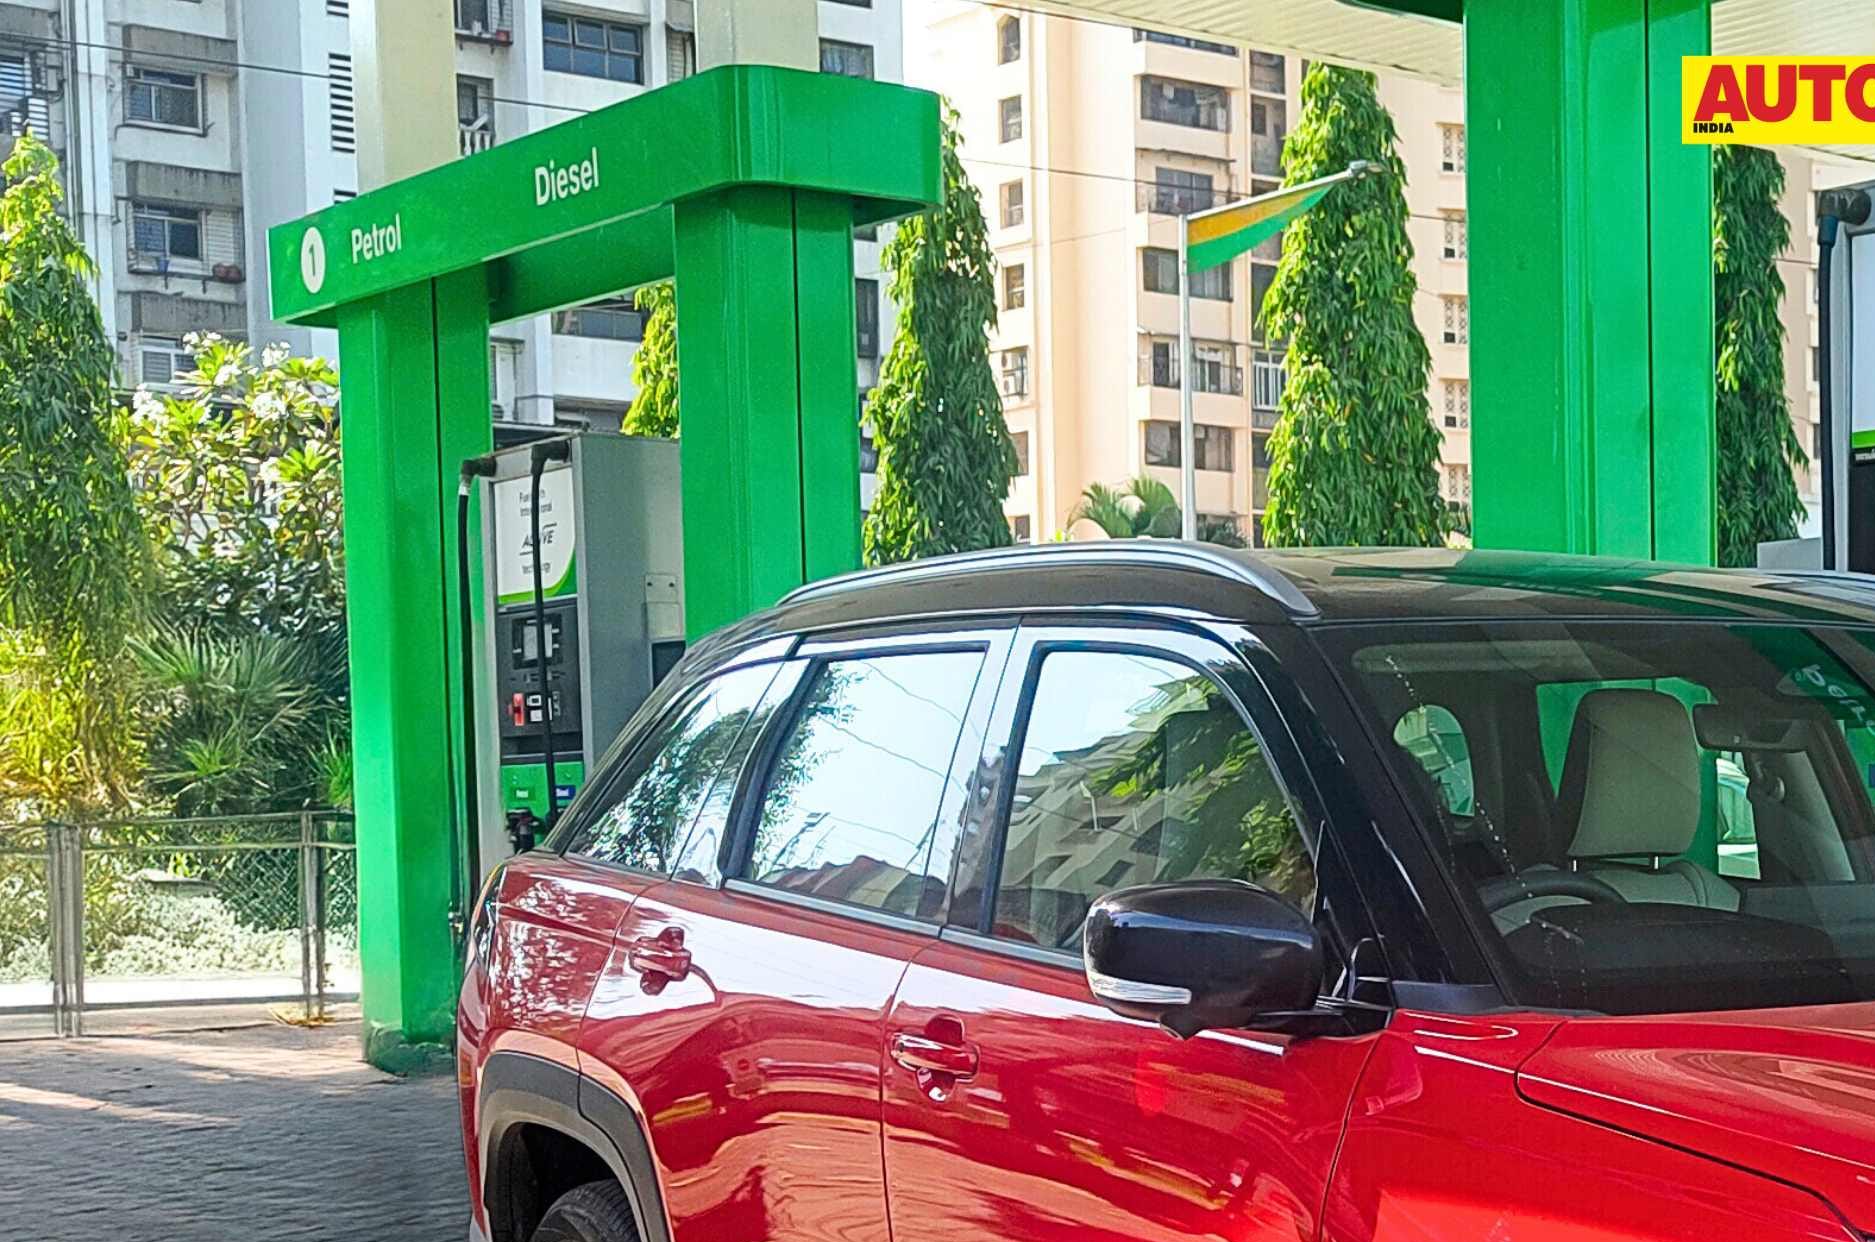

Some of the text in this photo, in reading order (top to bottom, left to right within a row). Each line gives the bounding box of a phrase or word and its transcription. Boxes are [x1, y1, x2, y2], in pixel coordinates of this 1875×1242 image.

[308, 146, 600, 277] 1 Petrol Diesel
